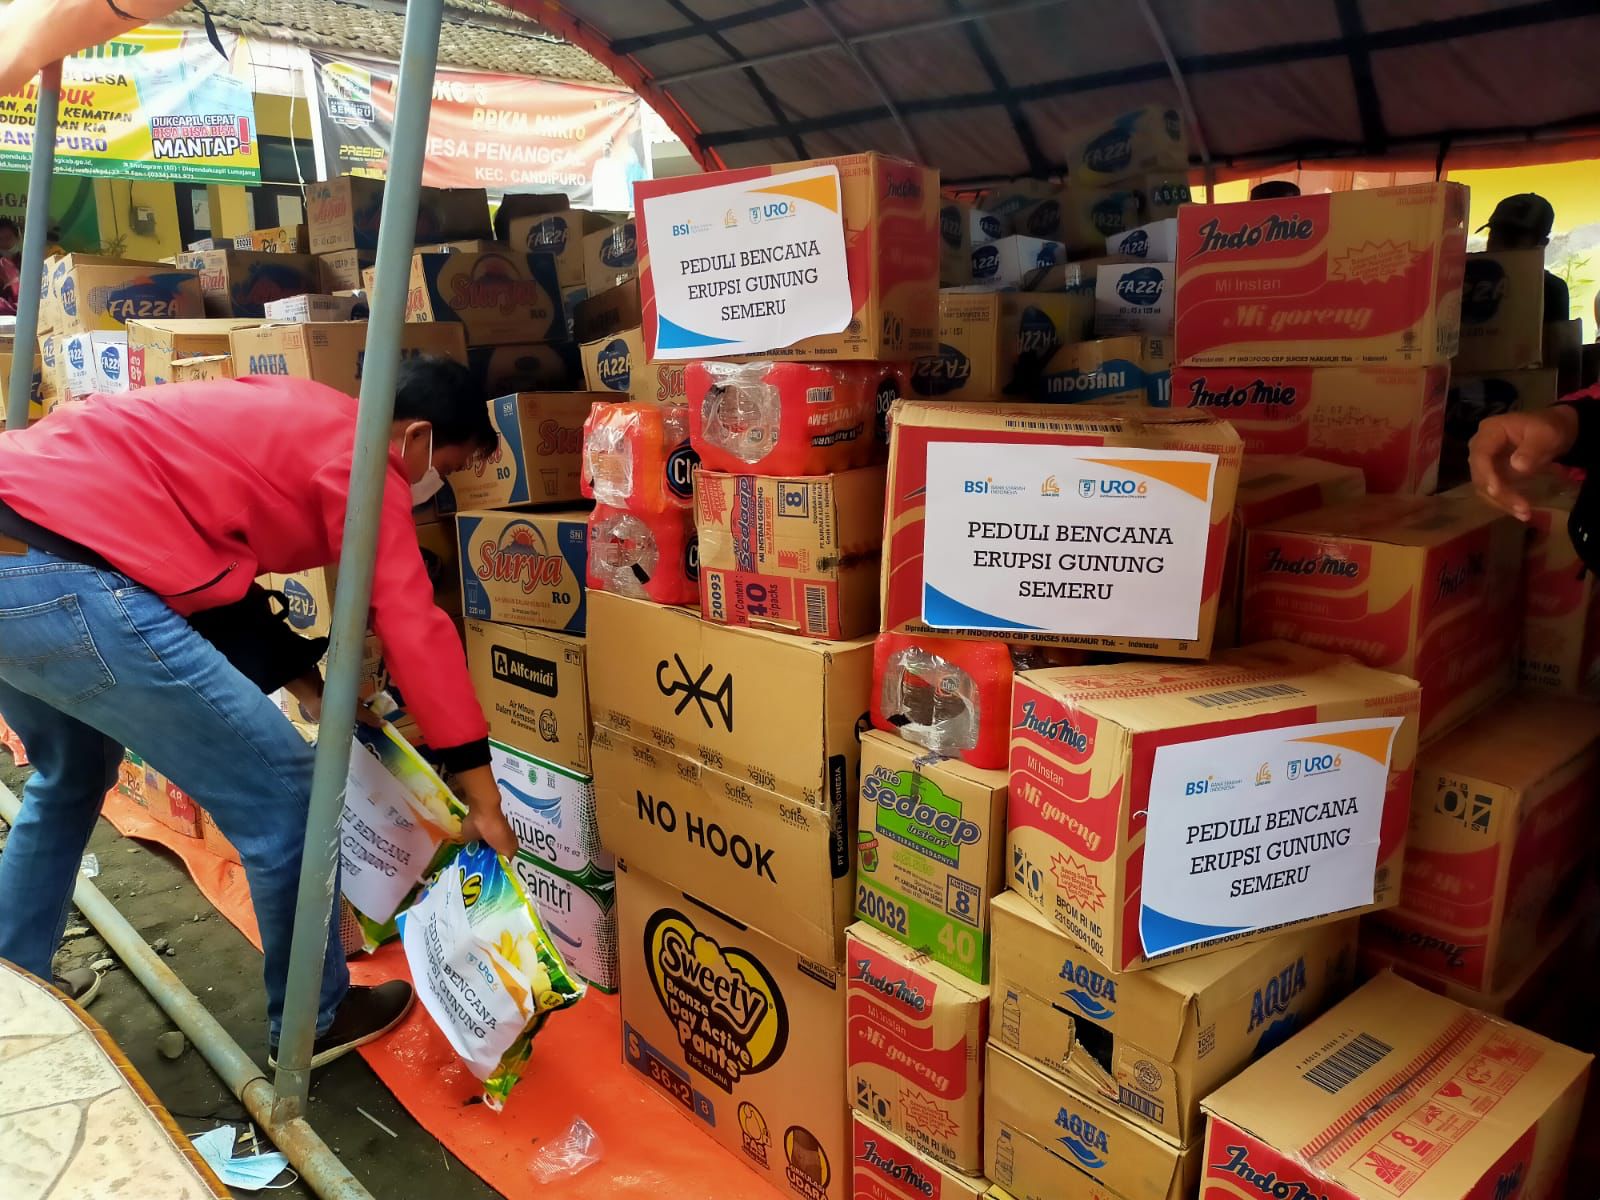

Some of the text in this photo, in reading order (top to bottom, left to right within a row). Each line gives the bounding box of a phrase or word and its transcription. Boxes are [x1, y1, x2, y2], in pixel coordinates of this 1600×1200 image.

[63, 107, 133, 122] KEMATIAN
[152, 115, 235, 127] DUKCAPIL CEPAT
[339, 144, 385, 159] PRESISI
[474, 167, 587, 187] KEC. CANDIPURO
[672, 222, 690, 237] BSI
[680, 240, 821, 276] PEDULI BENCANA
[688, 268, 818, 300] ERUPSI GUNUNG
[1215, 276, 1281, 292] Mi Instan
[721, 299, 787, 322] SEMERU
[1222, 304, 1374, 333] Mi goreng
[249, 353, 289, 376] AQUA
[1046, 371, 1125, 393] INDOSARI
[785, 491, 802, 507] 8
[963, 480, 989, 495] BSI
[739, 477, 752, 568] Sedaap
[967, 521, 1174, 545] PEDULI BENCANA
[477, 540, 564, 595] Surya
[973, 550, 1165, 574] ERUPSI GUNUNG
[551, 591, 571, 605] RO
[710, 573, 724, 620] 20093
[745, 583, 768, 617] 40
[1019, 580, 1114, 600] SEMERU
[967, 628, 1011, 639] INDOFOOD
[1012, 631, 1029, 641] CBP
[1030, 633, 1060, 643] SUKSES
[1061, 635, 1099, 646] MAKMUR
[873, 764, 901, 787] Mie
[1027, 755, 1066, 788] Mi Instan
[1185, 780, 1209, 796] BSI
[725, 783, 752, 802] Softex
[779, 804, 810, 827] Softex
[861, 775, 982, 847] Sedaap
[1016, 780, 1102, 852] Mi goreng
[1185, 796, 1359, 845] PEDULI BENCANA
[635, 789, 778, 885] NO HOOK
[906, 822, 951, 851] Instant
[1189, 828, 1352, 875] ERUPSI GUNUNG
[516, 861, 572, 913] Santri
[1230, 865, 1312, 898] SEMERU
[858, 884, 907, 936] 20032
[955, 890, 970, 915] 8
[1056, 894, 1103, 938] BPOM RI MD
[938, 921, 976, 965] 40
[444, 963, 497, 1031] BENCANA
[662, 934, 763, 1030] Sweety
[666, 977, 710, 1017] Bronze
[1059, 959, 1118, 1003] AQUA
[1246, 956, 1307, 1034] AQUA
[439, 979, 487, 1040] GUNUNG
[867, 1004, 908, 1037] Mi Instan
[669, 997, 750, 1066] Day Active
[677, 1019, 740, 1079] Pants
[858, 1024, 950, 1092] Mi goreng
[628, 1031, 692, 1107] S 36+2
[1054, 1106, 1110, 1154] AQUA
[941, 1144, 957, 1160] MD
